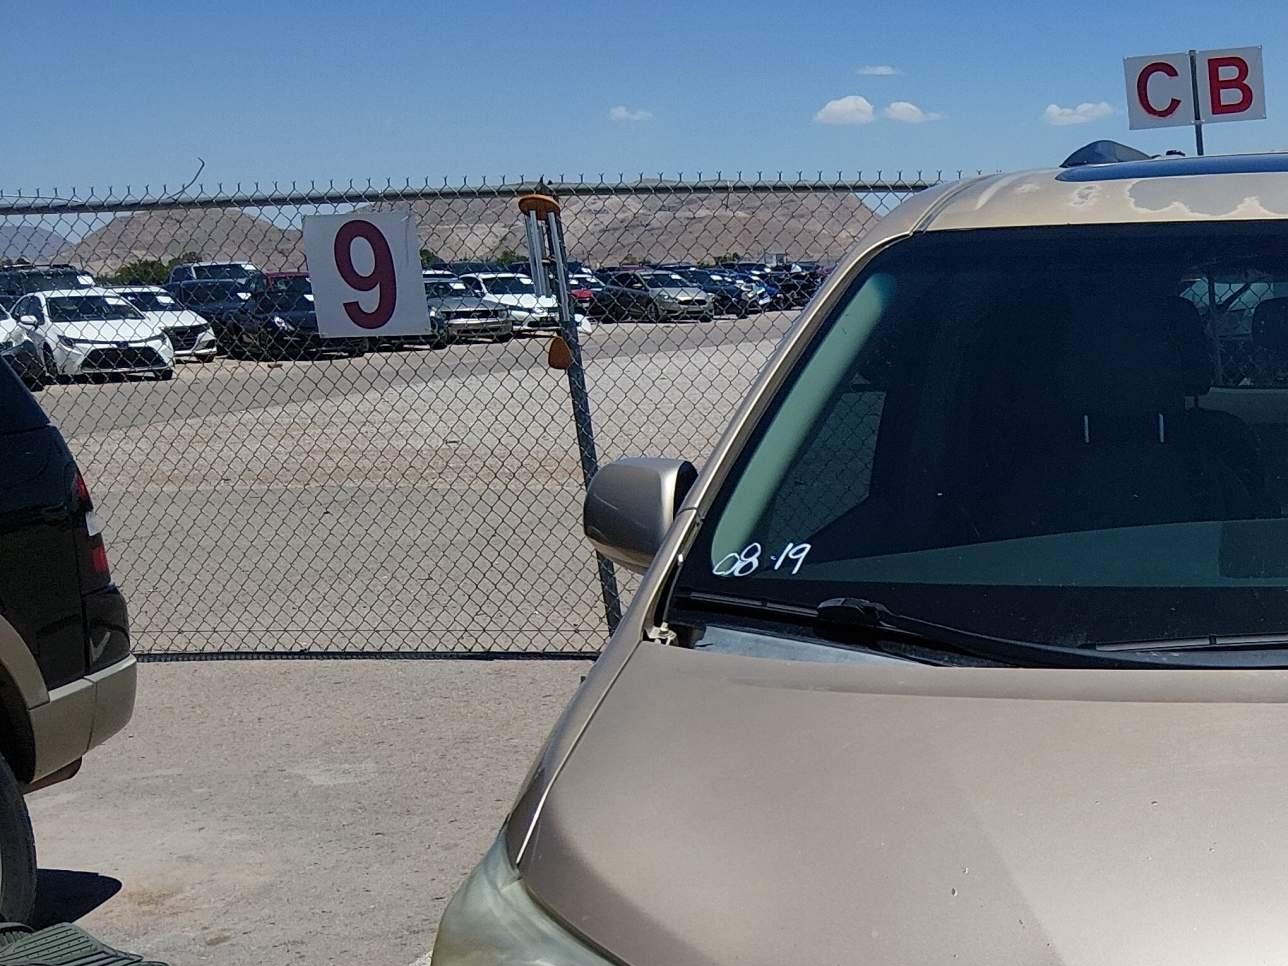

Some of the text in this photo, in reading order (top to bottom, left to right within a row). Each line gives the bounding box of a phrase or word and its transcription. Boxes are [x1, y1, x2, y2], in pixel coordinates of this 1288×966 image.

[1136, 62, 1181, 118] C
[1207, 56, 1253, 115] B
[333, 219, 397, 329] 9
